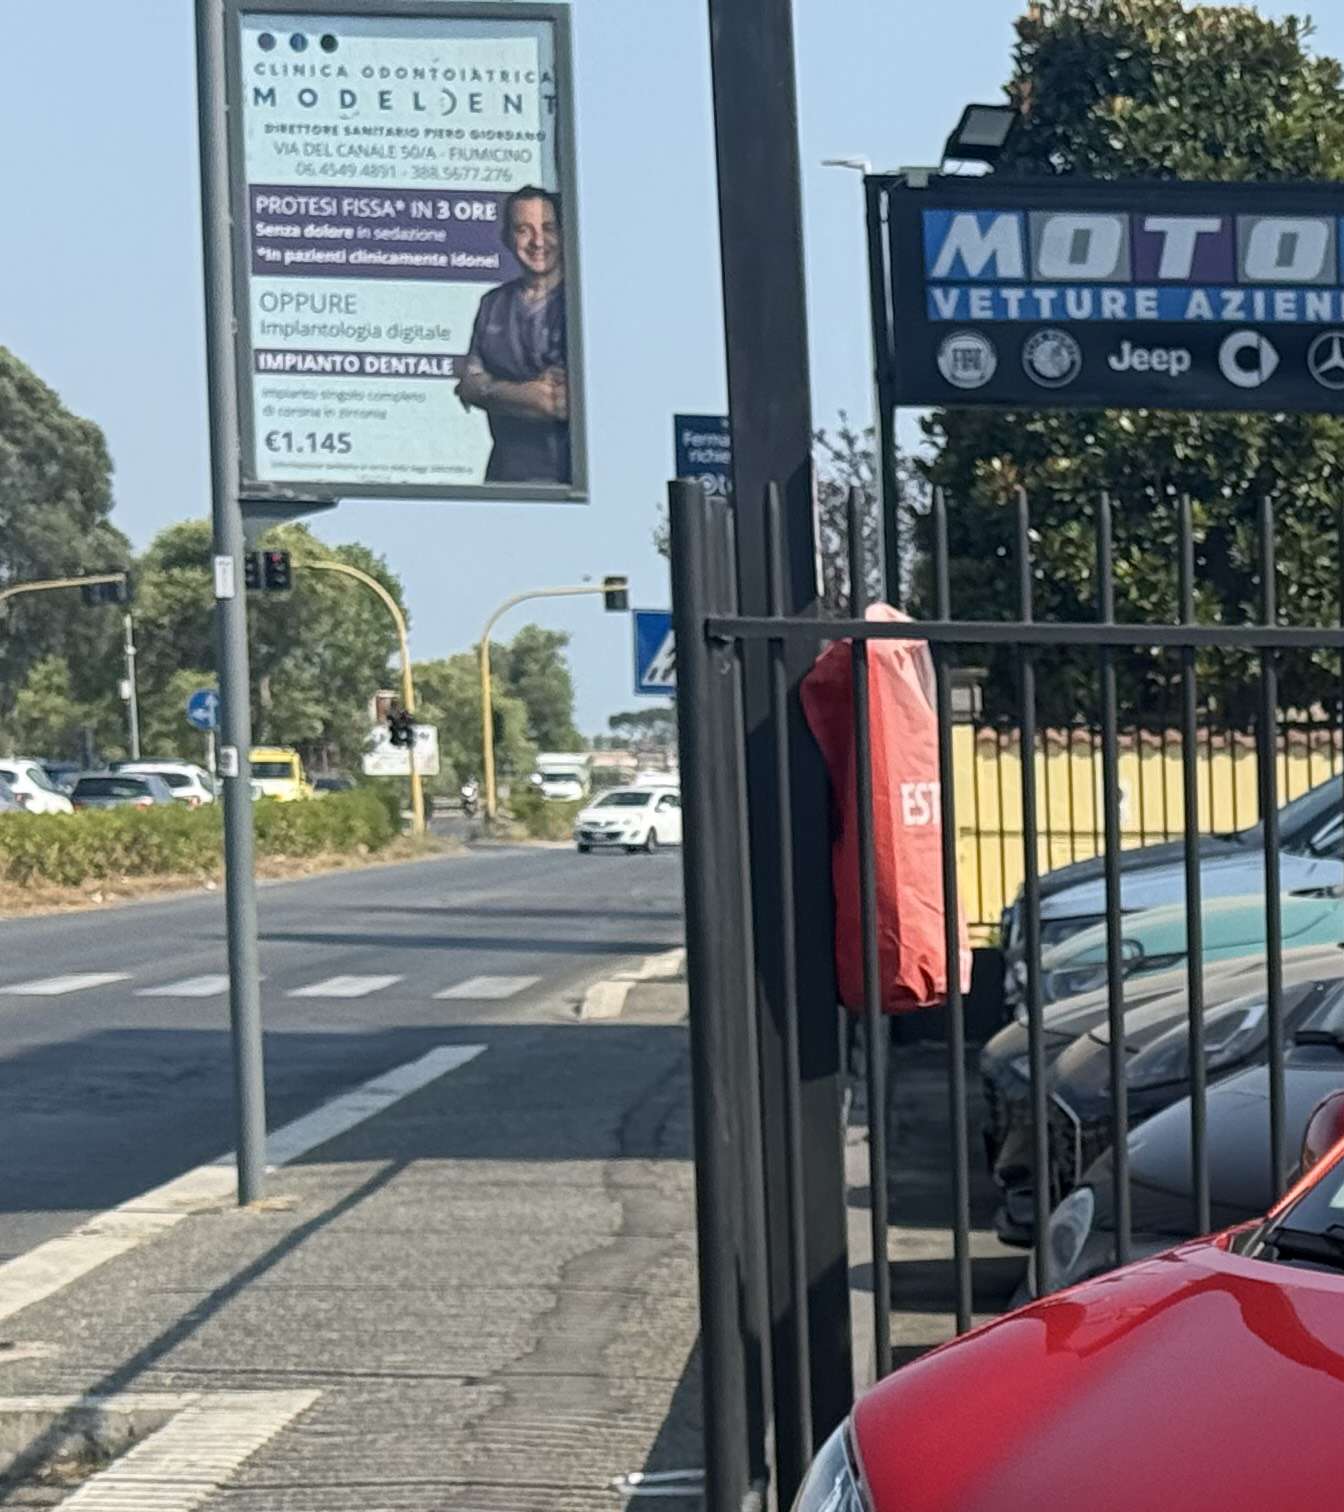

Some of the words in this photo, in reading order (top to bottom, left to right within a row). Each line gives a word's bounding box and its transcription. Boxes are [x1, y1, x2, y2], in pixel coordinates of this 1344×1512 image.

[253, 61, 349, 79] CLINICA
[361, 65, 553, 84] ODONTOIATRICA
[273, 141, 299, 156] VIA
[302, 142, 333, 158] DEL
[336, 143, 397, 160] CANALE
[255, 194, 338, 217] PROTESI
[410, 199, 433, 219] IN
[436, 200, 451, 220] 3
[454, 201, 498, 222] ORE
[255, 221, 301, 238] Senza
[259, 291, 358, 315] OPPURE
[931, 287, 1159, 321] VETTURE
[258, 352, 360, 374] IMPIANTO
[364, 356, 454, 376] DENTALE
[1107, 340, 1192, 378] Jeep
[265, 430, 353, 455] €1.145
